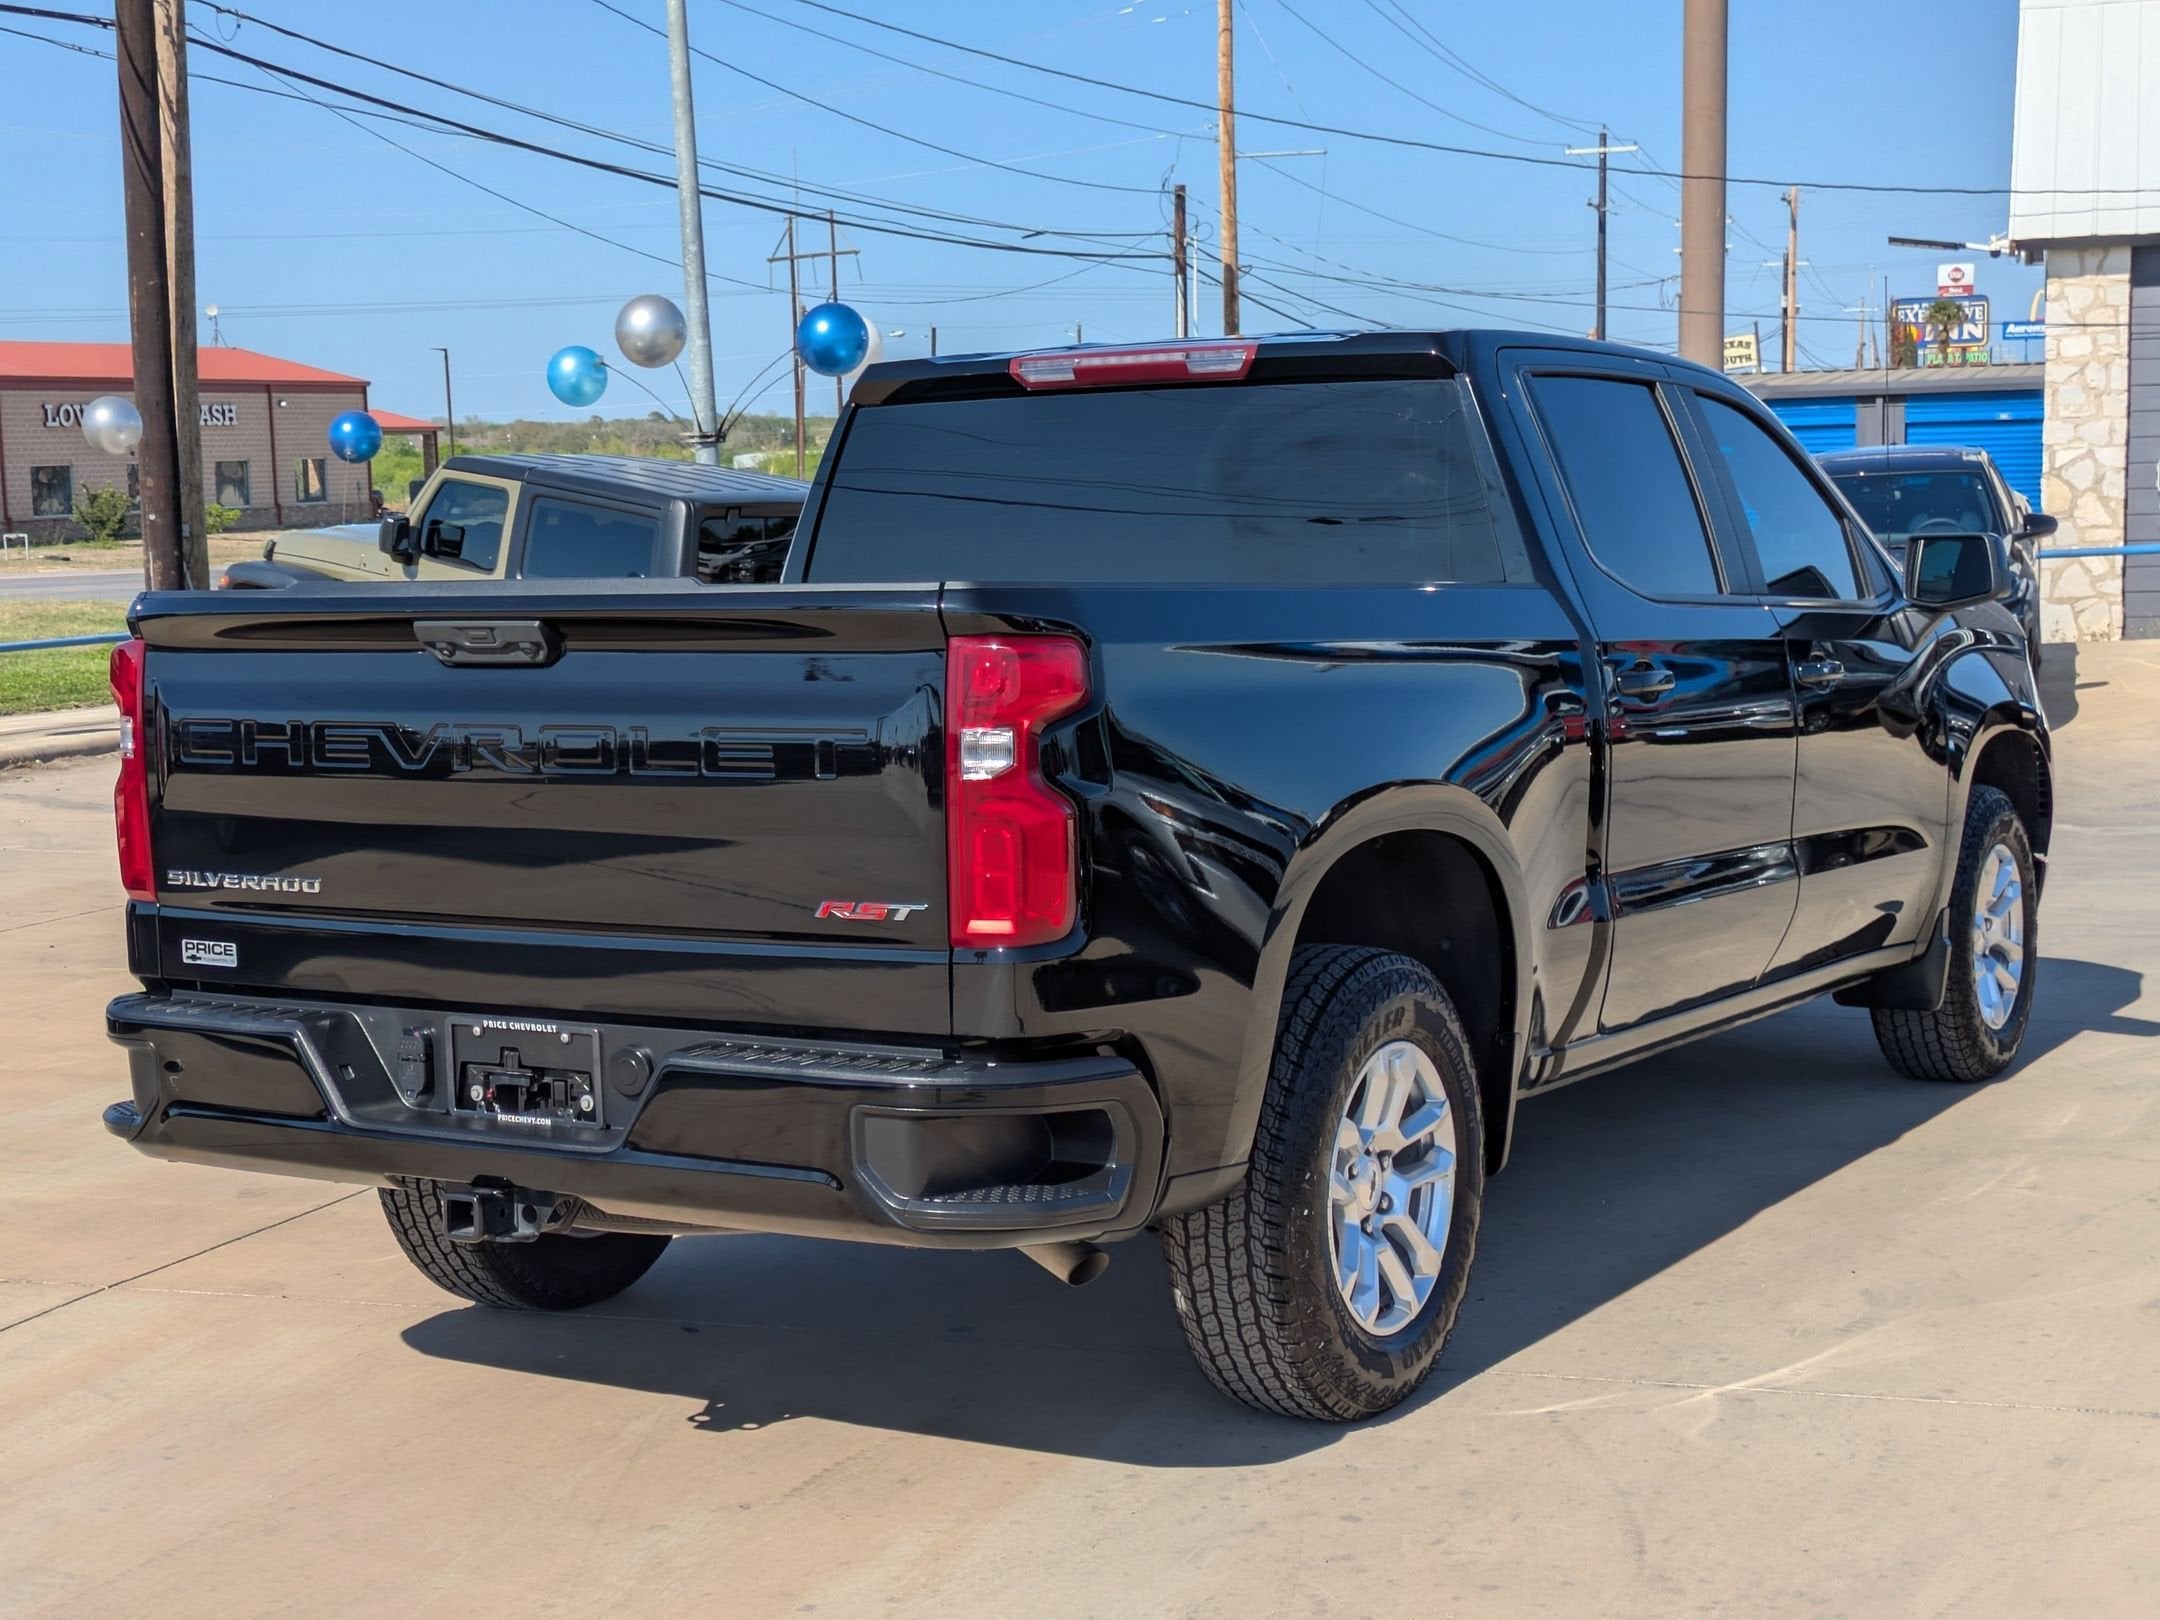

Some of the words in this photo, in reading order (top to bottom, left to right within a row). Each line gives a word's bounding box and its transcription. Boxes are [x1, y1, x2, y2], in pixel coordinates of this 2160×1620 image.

[1724, 354, 1752, 365] OUTH
[44, 404, 86, 427] LOV
[199, 404, 239, 426] ASH
[178, 718, 867, 780] CHEVROLET
[167, 869, 322, 893] SILVERADO
[815, 901, 928, 921] RST
[185, 941, 235, 956] PRICE
[483, 1019, 507, 1029] PRICE
[509, 1021, 557, 1033] CHEVROLET
[497, 1114, 552, 1126] PRICECHEVY.COM
